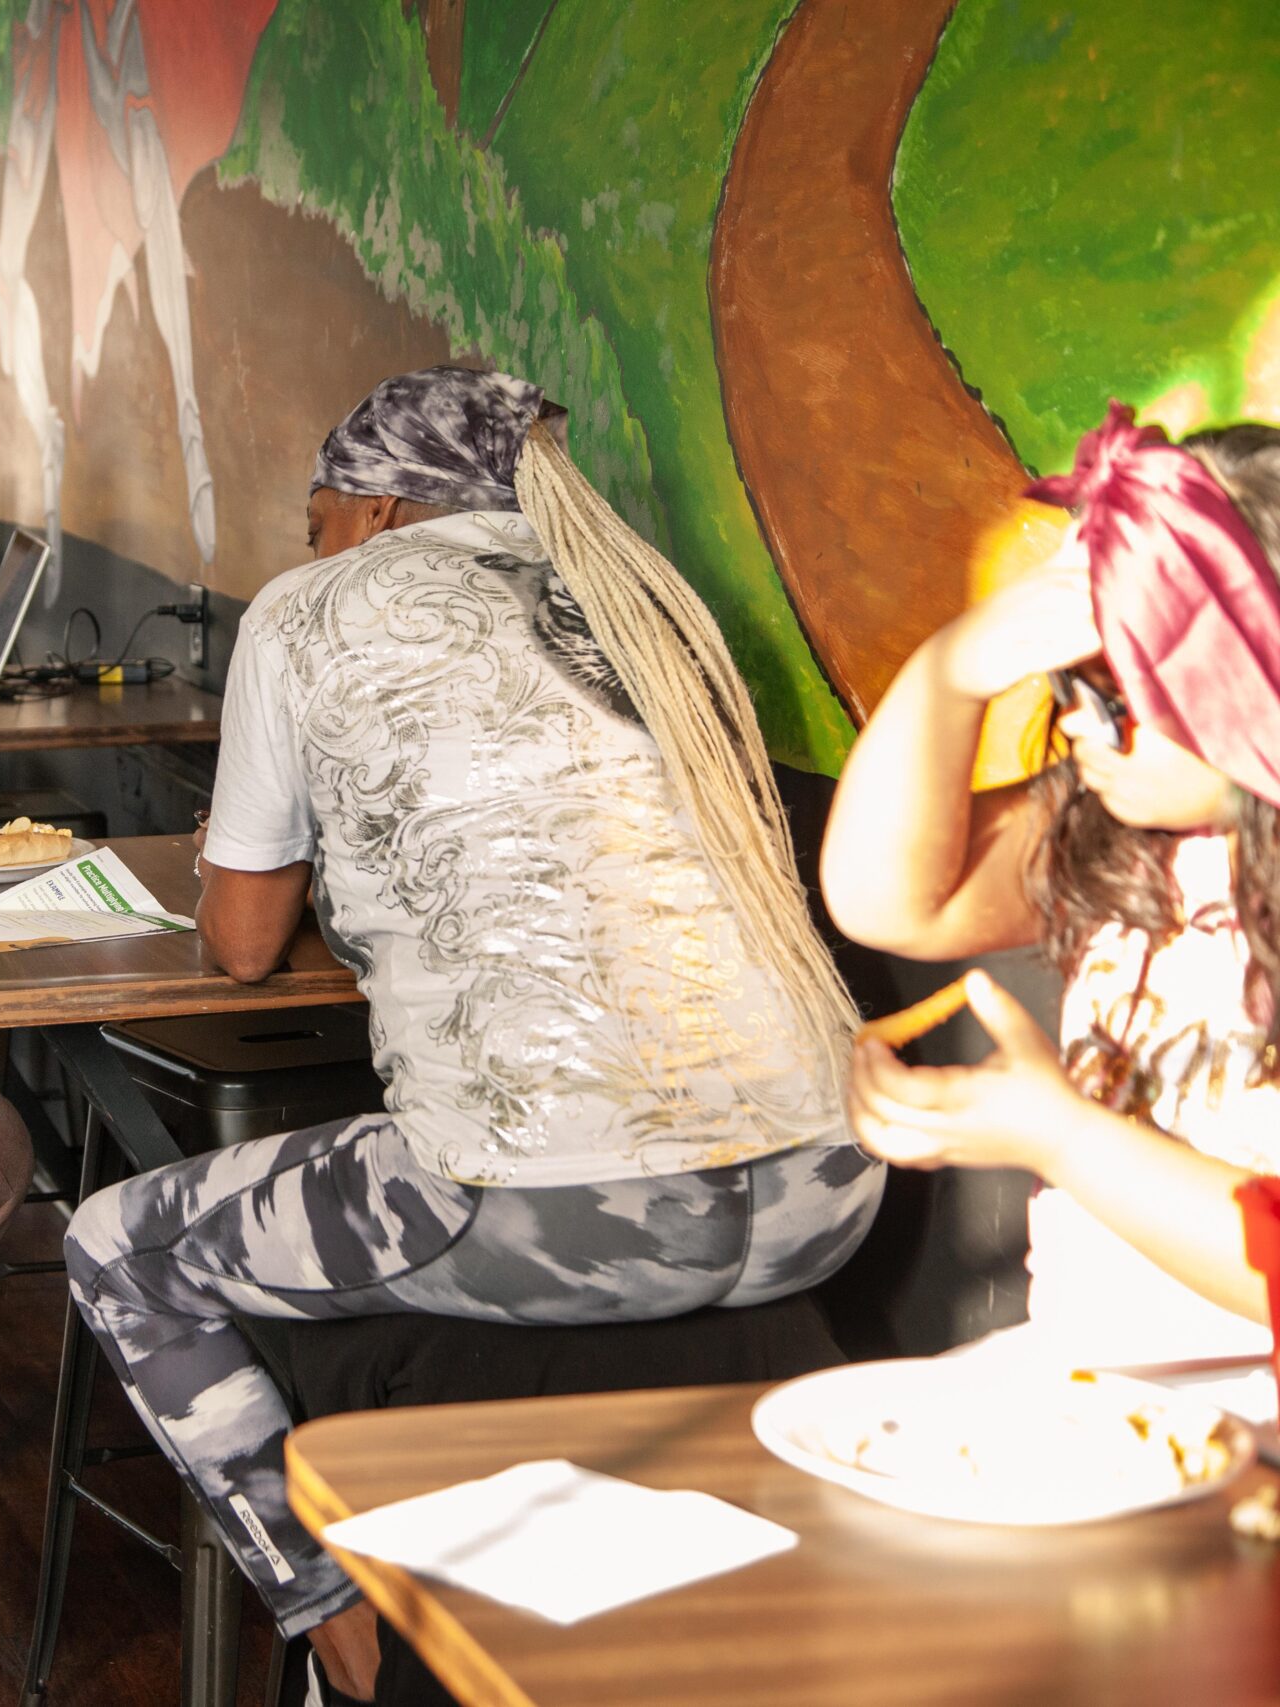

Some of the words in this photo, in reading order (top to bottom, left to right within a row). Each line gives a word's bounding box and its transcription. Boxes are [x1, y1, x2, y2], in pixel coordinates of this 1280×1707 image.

[46, 879, 66, 901] EXAMPLE
[82, 865, 103, 886] Practice
[99, 883, 125, 914] Multiplying
[240, 1510, 272, 1552] Reebok
